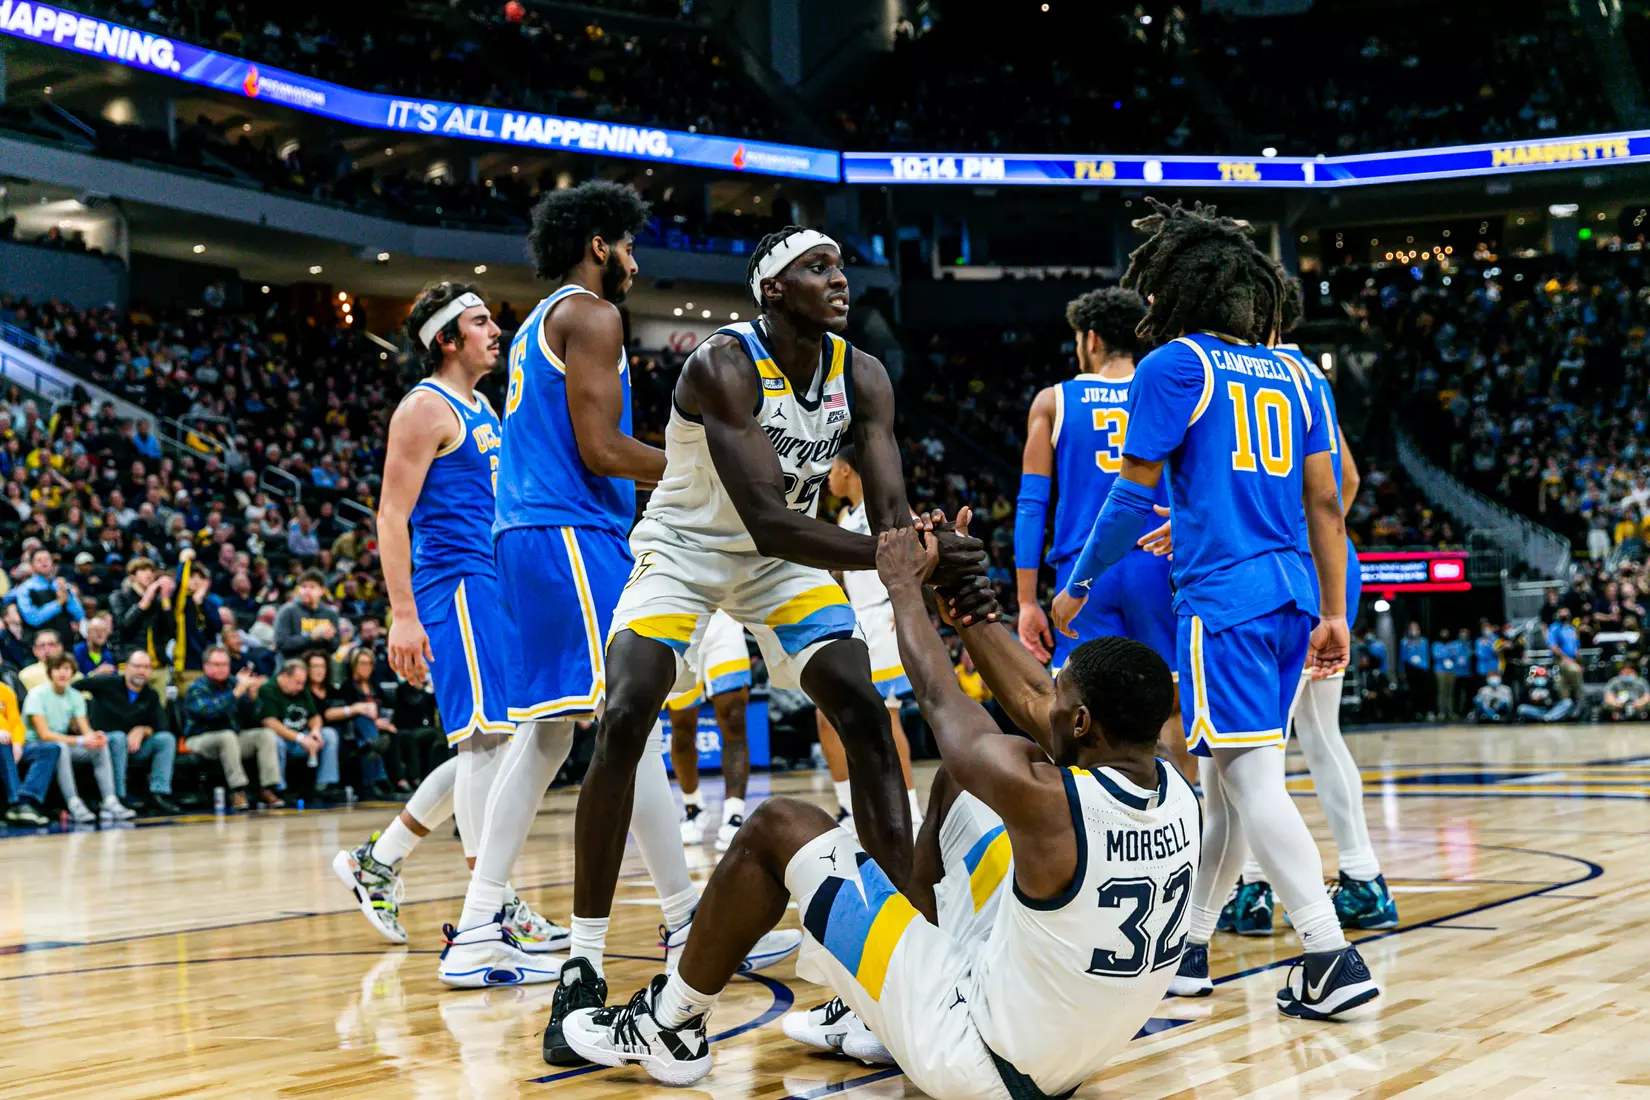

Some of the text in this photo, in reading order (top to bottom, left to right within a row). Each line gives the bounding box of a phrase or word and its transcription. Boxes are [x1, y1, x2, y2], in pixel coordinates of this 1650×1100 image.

[387, 99, 674, 158] IT'S ALL HAPPENING.
[890, 156, 1006, 180] 10:14 PM
[1492, 138, 1630, 168] MARQUETTE
[1301, 162, 1316, 184] 1
[1210, 349, 1292, 382] CAMPBELL
[1081, 387, 1129, 403] JUZAN
[1226, 381, 1293, 478] 10
[1106, 818, 1190, 862] MORSELL
[1084, 861, 1194, 978] 32
